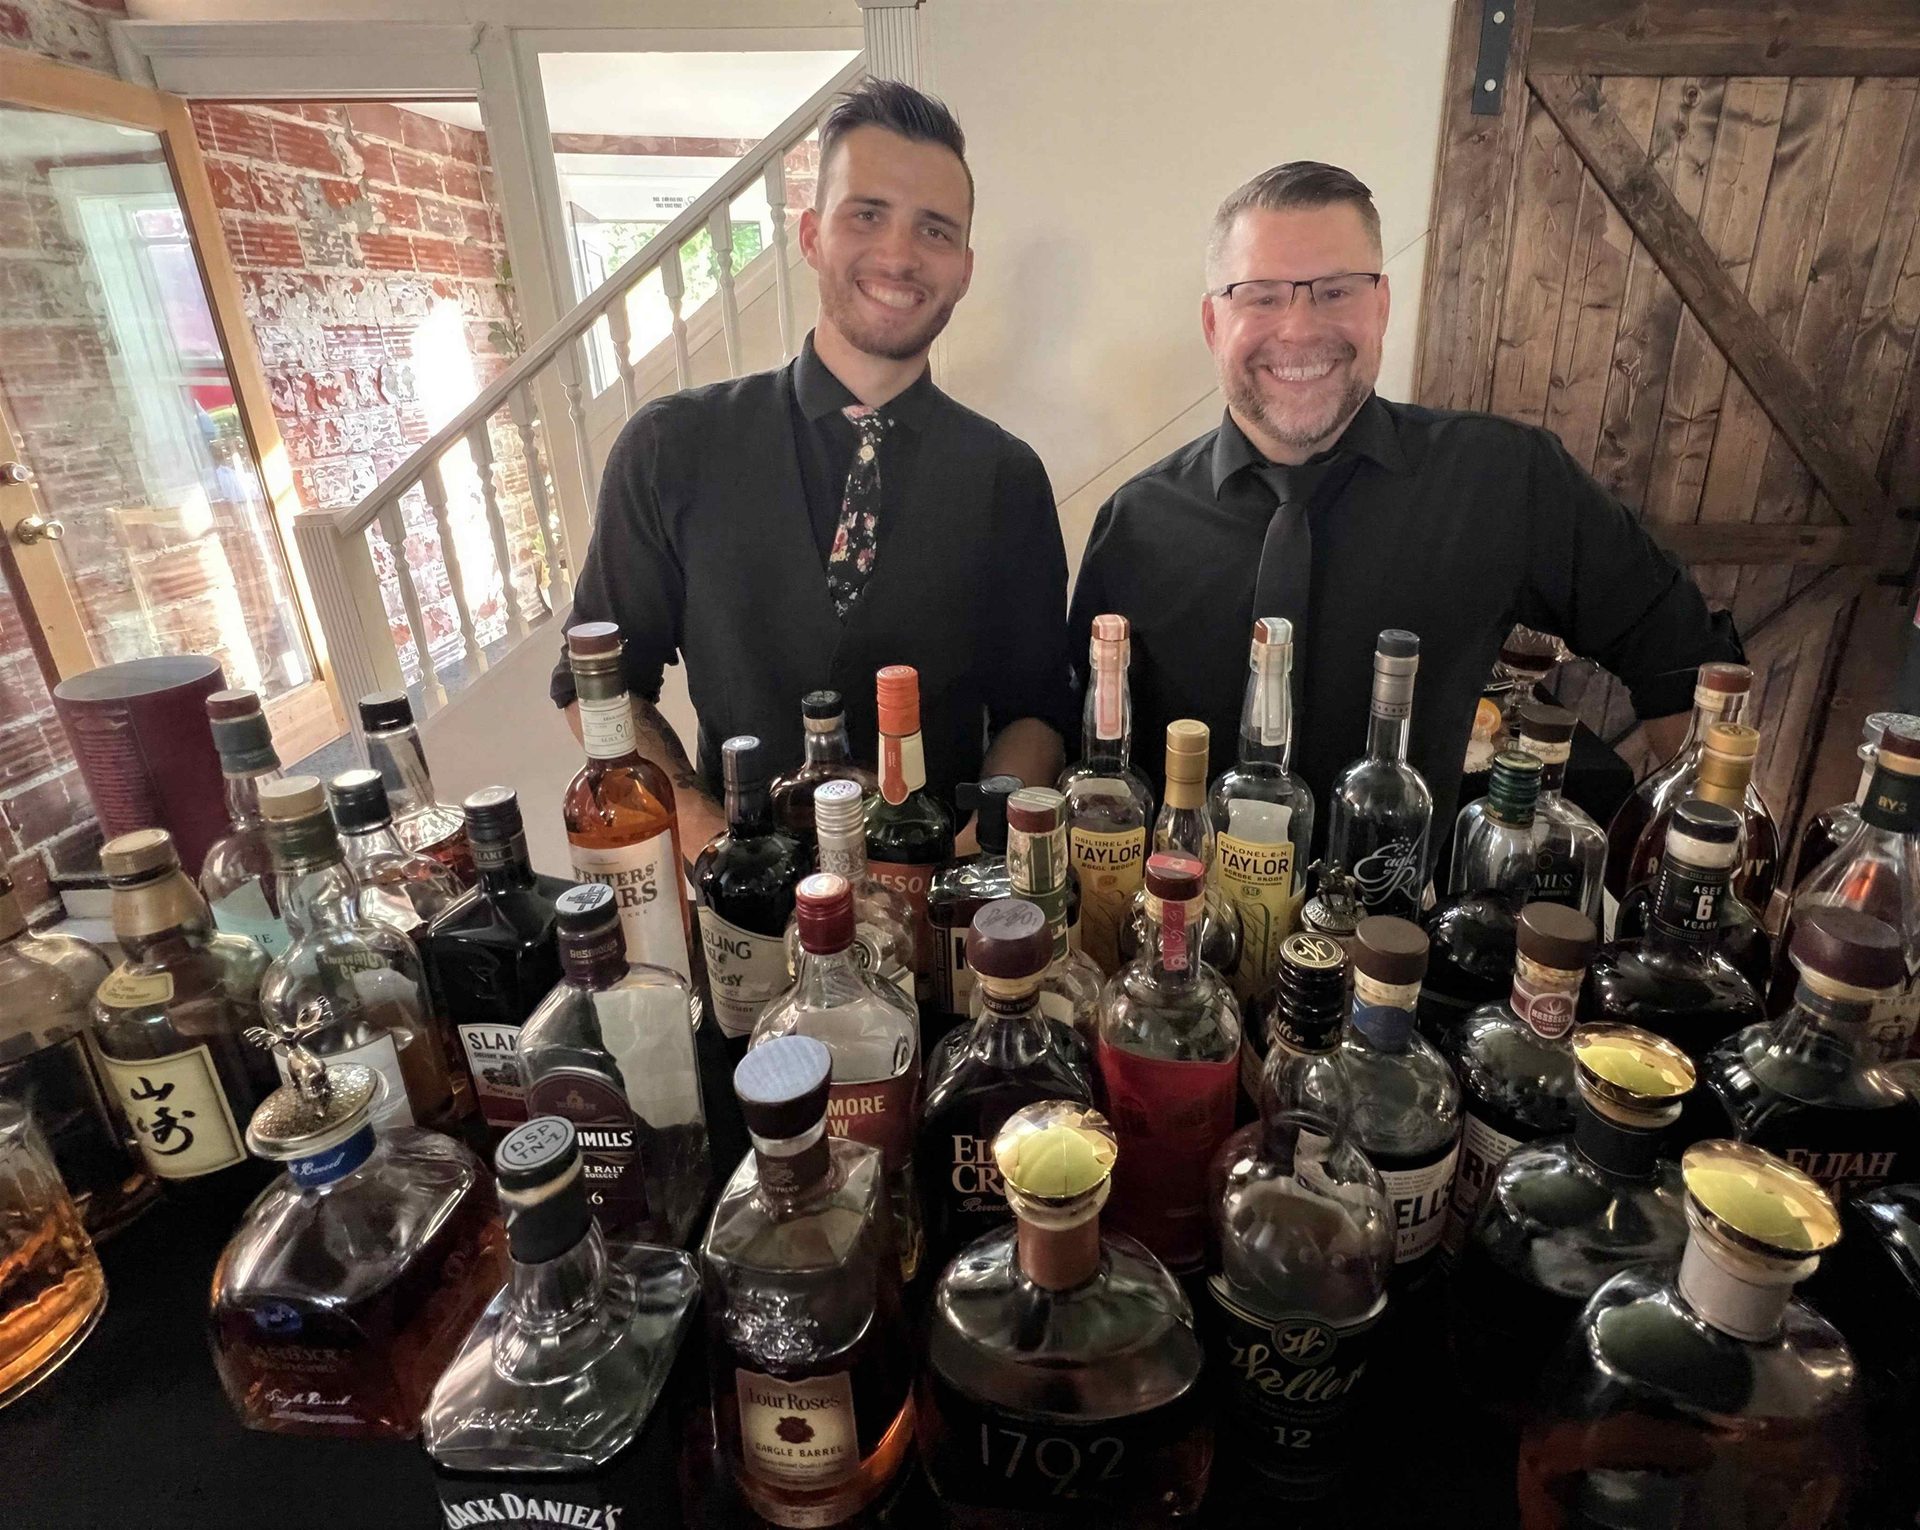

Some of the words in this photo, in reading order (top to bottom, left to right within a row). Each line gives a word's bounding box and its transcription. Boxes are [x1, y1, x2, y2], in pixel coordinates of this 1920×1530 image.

[1075, 843, 1141, 864] TAYLOR
[1220, 848, 1289, 875] TAYLOR
[1696, 895, 1714, 920] 6
[510, 1124, 550, 1153] DSP
[1785, 1148, 1898, 1182] ELIJAH
[1226, 1335, 1368, 1402] Weller
[1273, 1425, 1313, 1449] 12
[979, 1422, 1126, 1496] 1792
[447, 1498, 506, 1530] JACK
[500, 1493, 623, 1530] DANIEL'S
